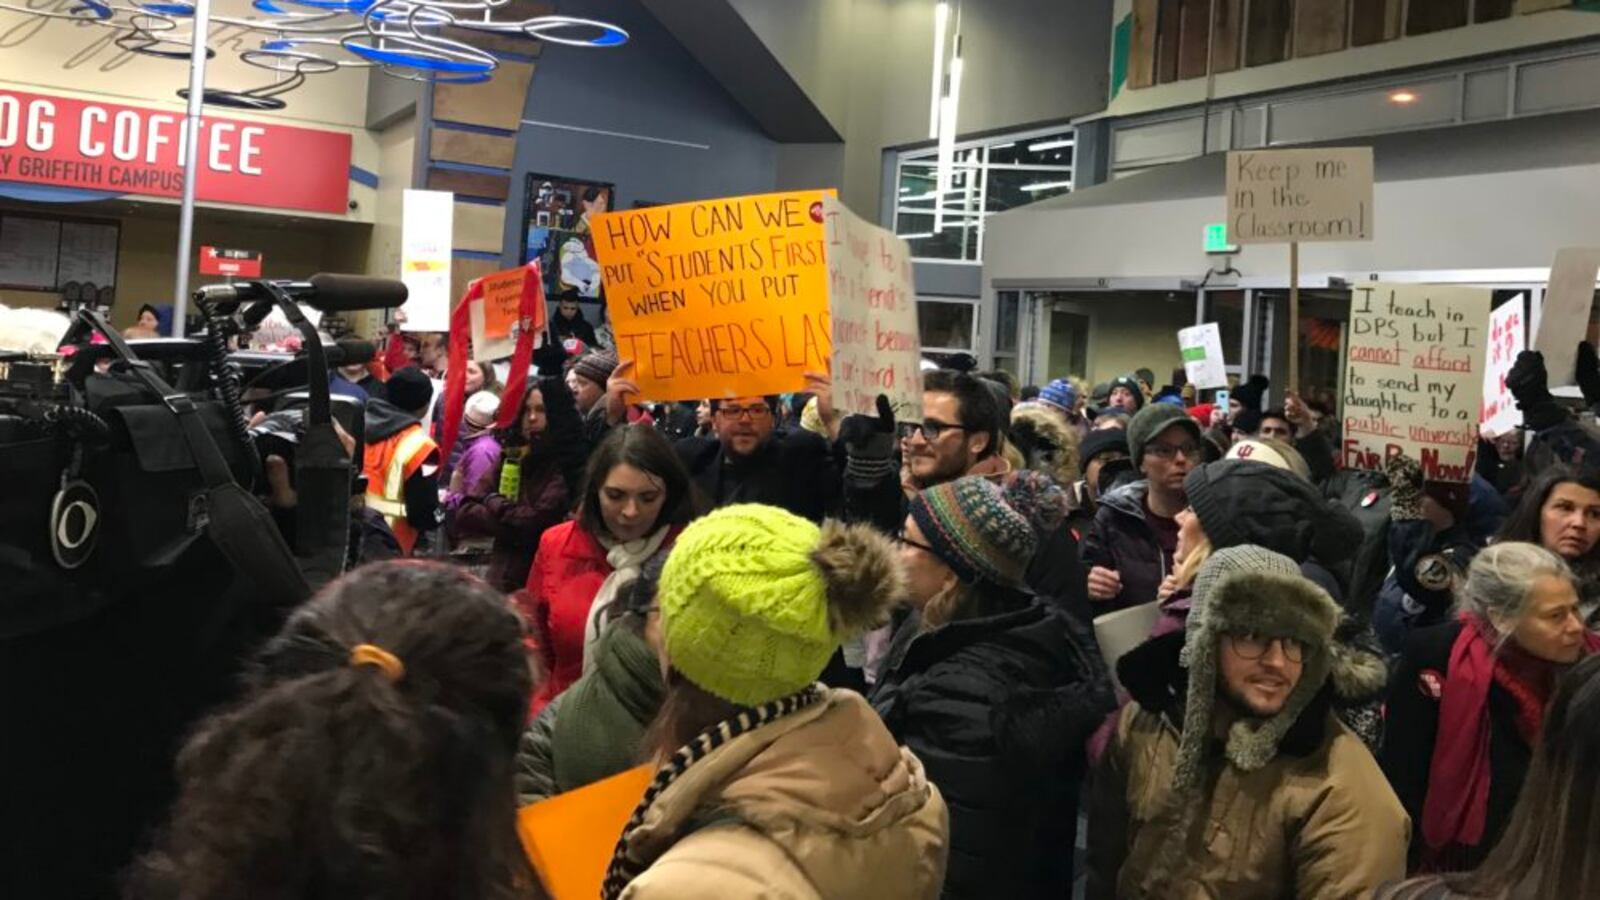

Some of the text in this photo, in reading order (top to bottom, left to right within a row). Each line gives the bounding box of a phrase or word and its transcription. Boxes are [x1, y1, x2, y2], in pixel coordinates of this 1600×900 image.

[80, 106, 265, 175] COFFEE
[0, 154, 184, 192] Y GRIFFITH CAMPUS
[1238, 153, 1347, 190] Keep me
[1235, 187, 1310, 208] in the
[606, 198, 804, 250] HOW CAN WE
[1235, 202, 1366, 239] Classroom!
[604, 262, 634, 287] PUT
[769, 235, 825, 269] FIRST
[627, 288, 686, 316] WHEN
[700, 278, 745, 309] YOU
[761, 274, 799, 298] PUT
[1355, 287, 1464, 322] I teach in
[620, 317, 774, 381] TEACHERS
[781, 311, 832, 376] LAS
[1353, 317, 1399, 338] DPS
[1413, 322, 1444, 342] but
[1457, 327, 1478, 348] I
[1350, 340, 1407, 366] cannot
[1412, 345, 1471, 372] afford
[1346, 366, 1456, 402] to send my
[1344, 388, 1417, 418] daughter
[1430, 396, 1449, 419] to
[1457, 409, 1468, 420] a
[1345, 414, 1402, 437] public
